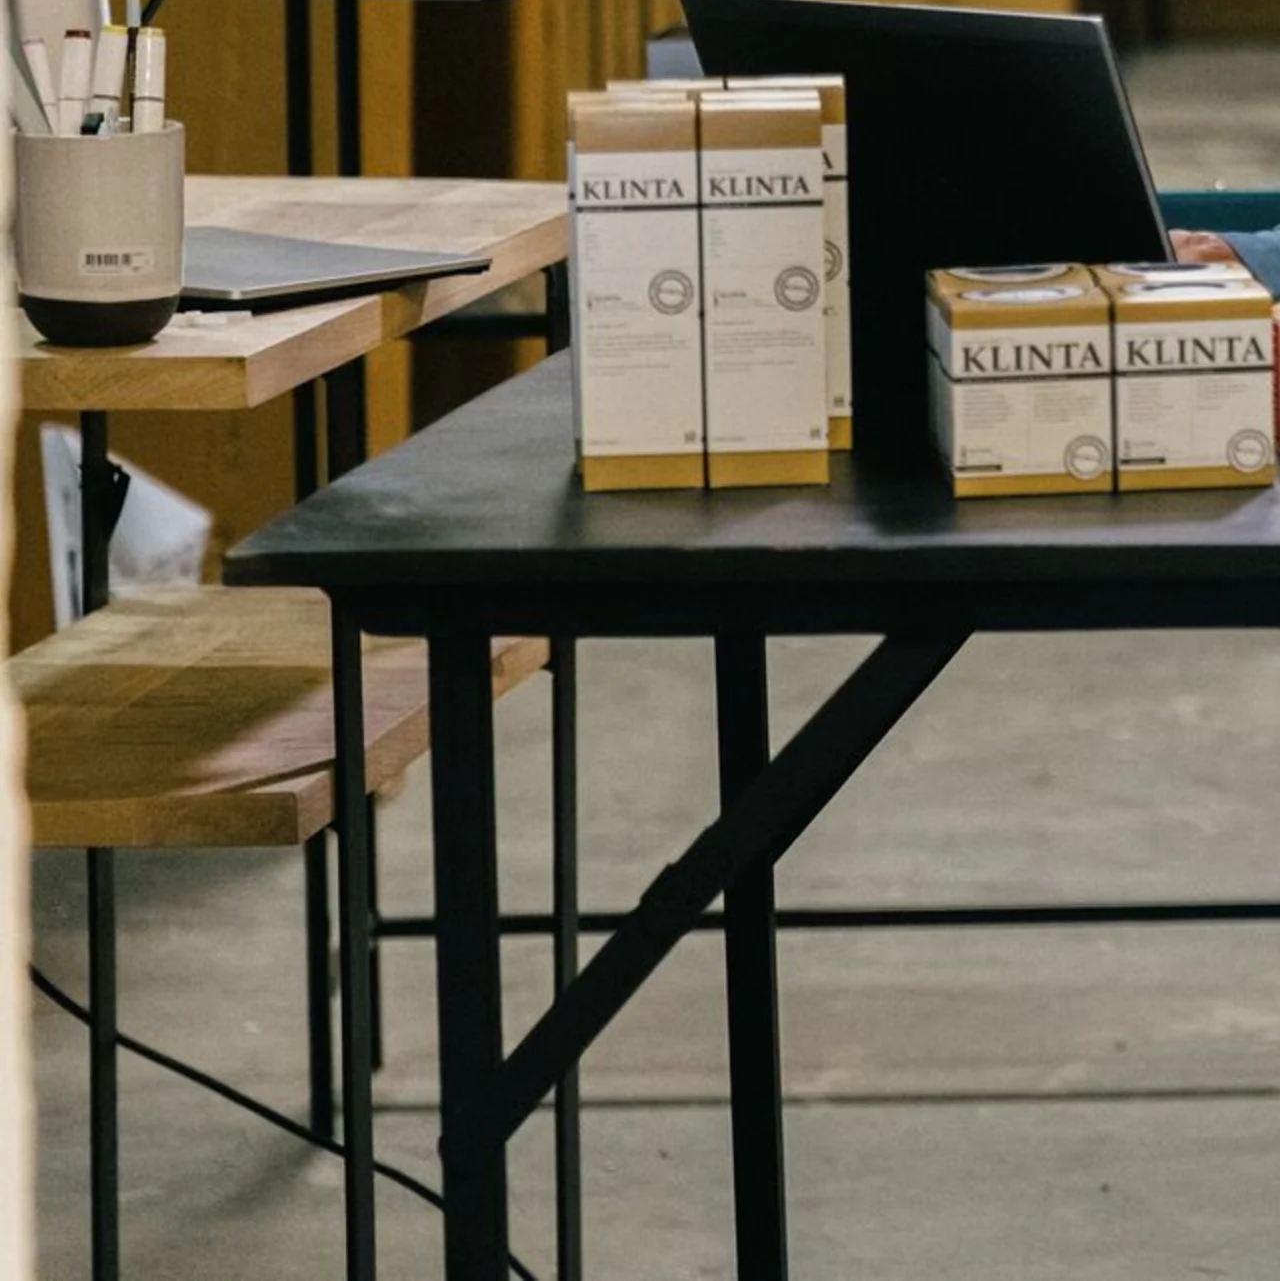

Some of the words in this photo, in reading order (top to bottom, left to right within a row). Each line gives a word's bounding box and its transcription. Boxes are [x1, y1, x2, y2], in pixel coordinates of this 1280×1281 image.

[582, 178, 685, 202] KLINTA
[709, 174, 811, 198] KLINTA
[962, 341, 1103, 374] KLINTA
[1126, 336, 1267, 367] KLINTA
